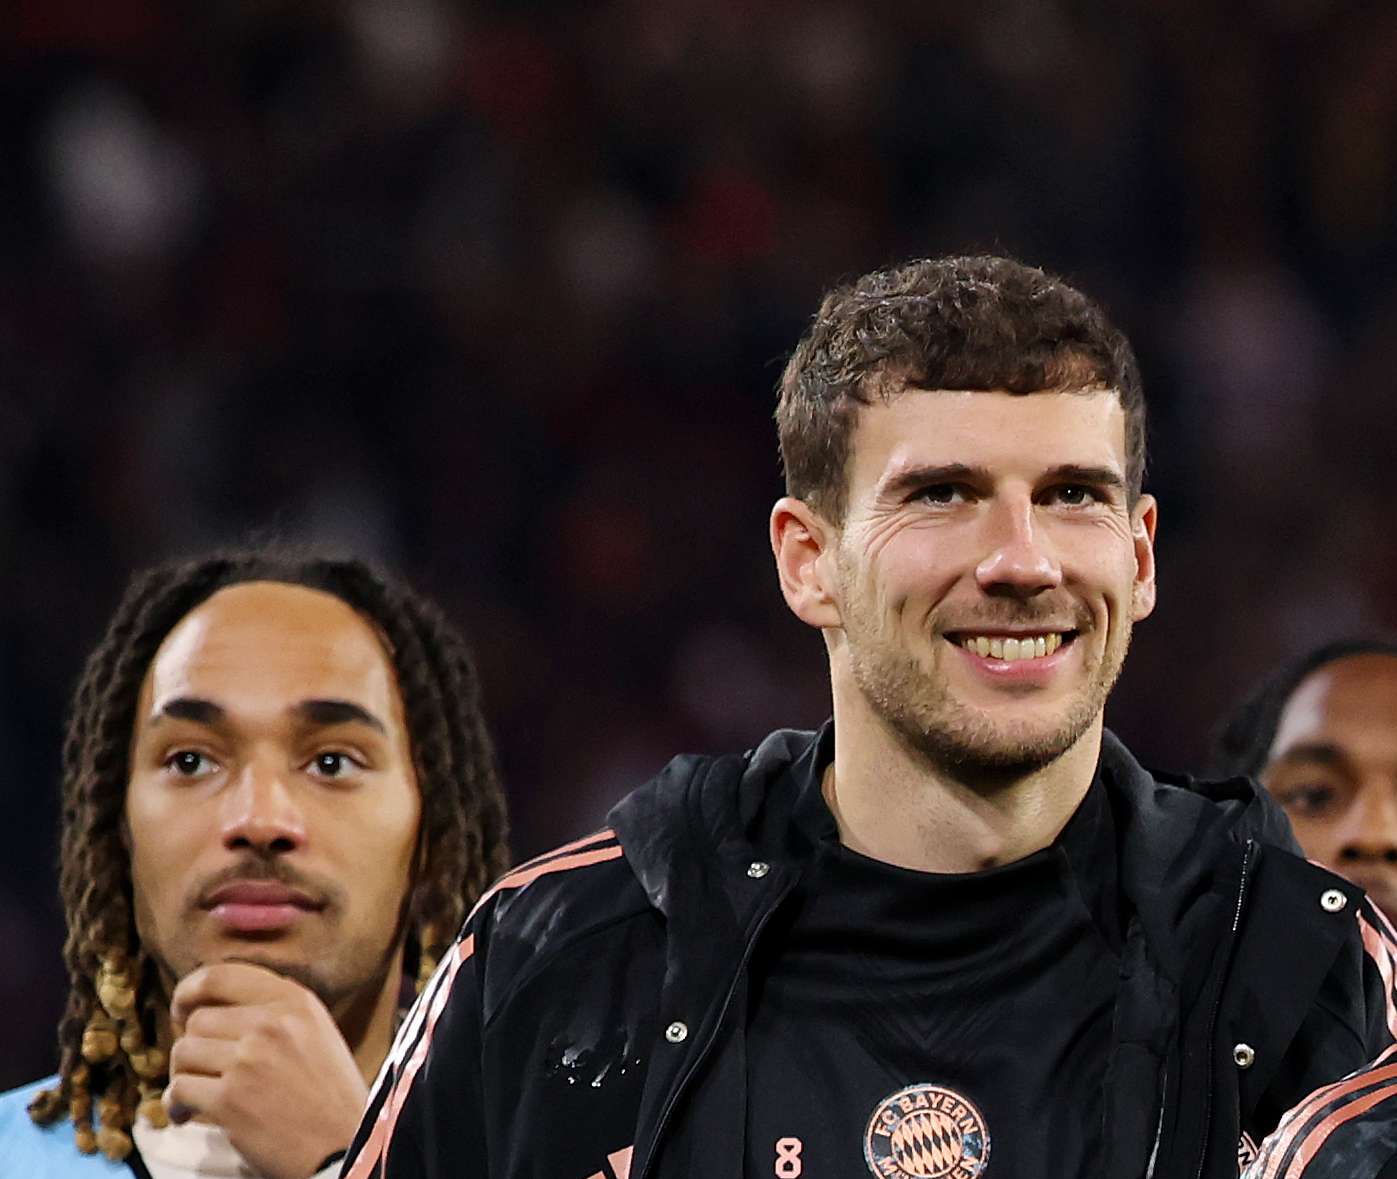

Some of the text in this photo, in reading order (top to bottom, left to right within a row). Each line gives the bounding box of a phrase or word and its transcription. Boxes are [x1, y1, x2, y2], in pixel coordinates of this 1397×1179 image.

[875, 1093, 978, 1137] FC BAYERN
[775, 1137, 802, 1179] 8
